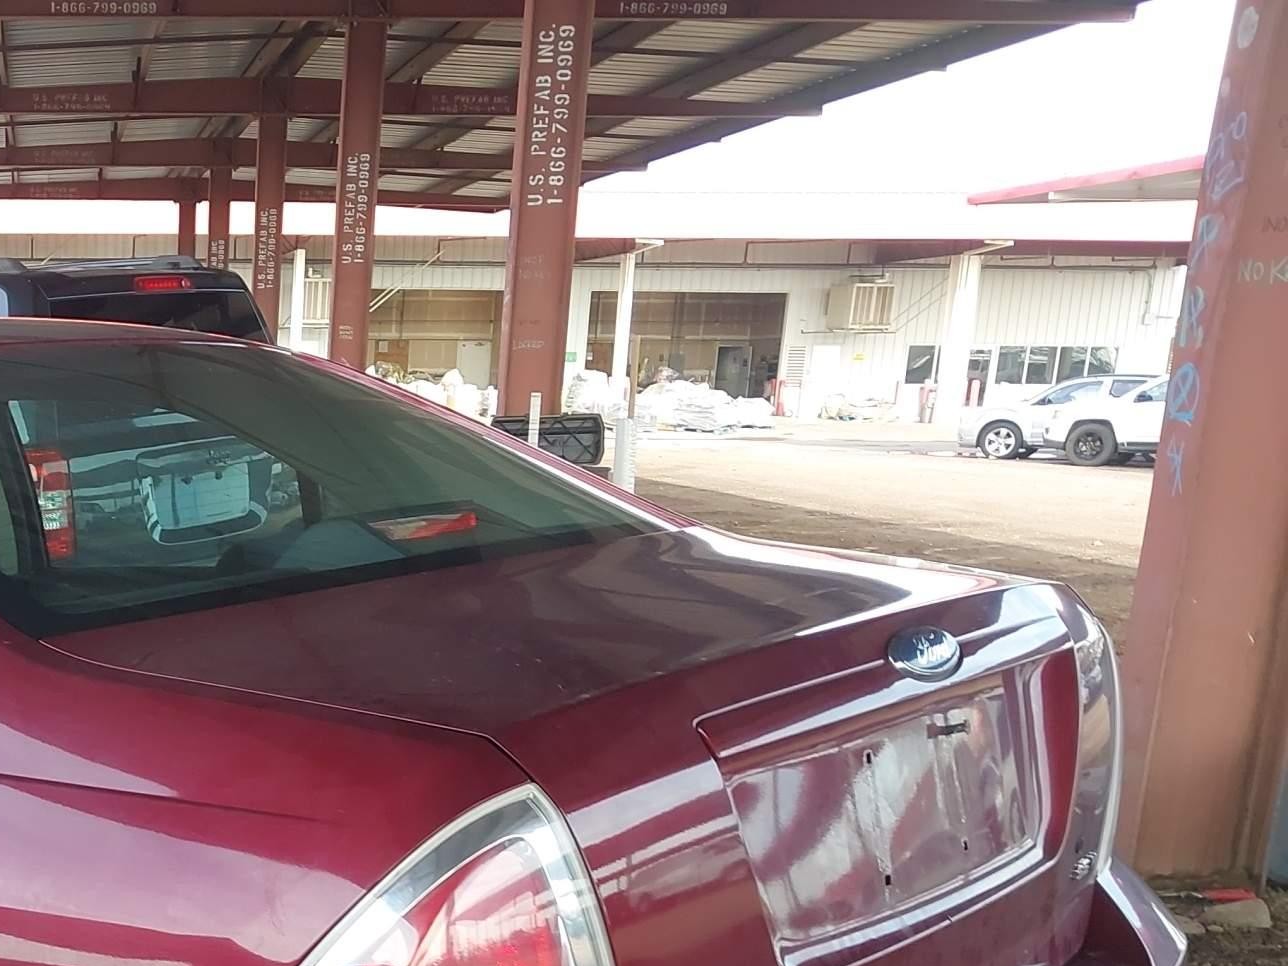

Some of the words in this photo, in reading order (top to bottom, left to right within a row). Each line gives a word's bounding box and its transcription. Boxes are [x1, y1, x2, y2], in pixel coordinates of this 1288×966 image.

[51, 2, 157, 14] 1-866-799-0969
[537, 23, 556, 63] INC.
[531, 75, 552, 155] PREFAB
[547, 25, 576, 205] 1-866-799-0969
[344, 183, 357, 233] PREFAB
[527, 168, 546, 206] U.S.
